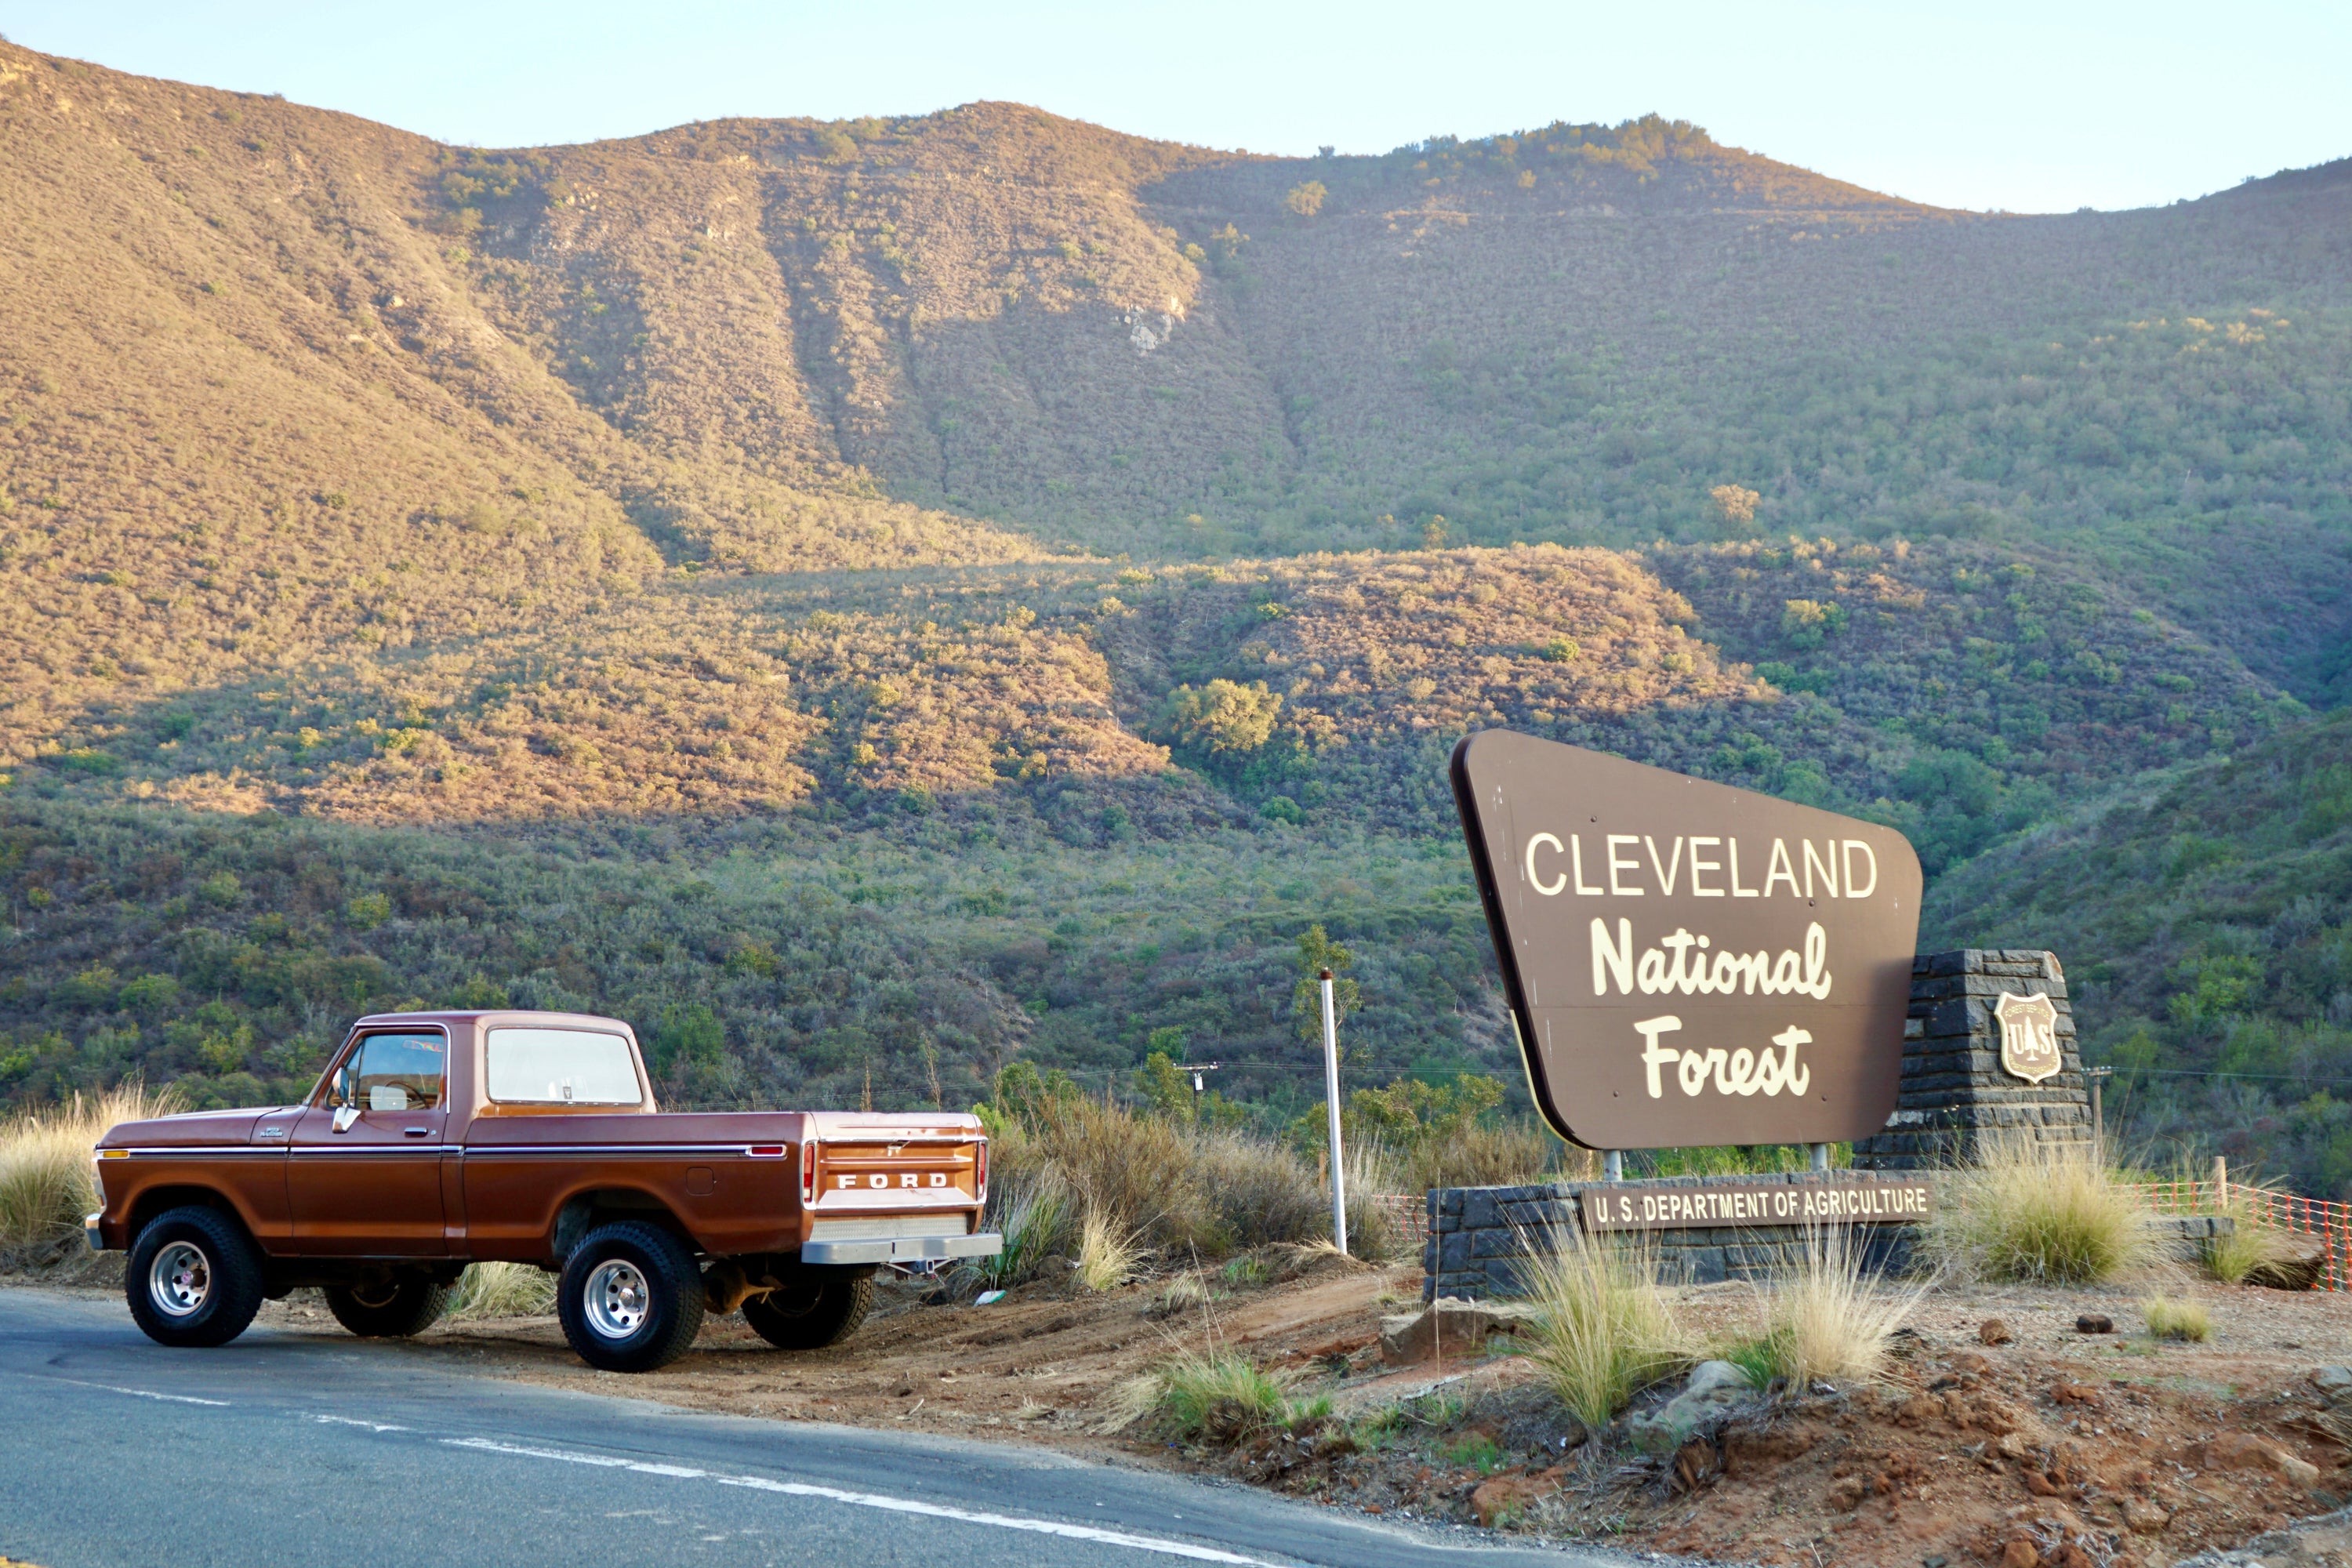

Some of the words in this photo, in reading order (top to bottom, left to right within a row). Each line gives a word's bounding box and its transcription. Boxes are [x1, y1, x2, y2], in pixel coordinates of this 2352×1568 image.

[1525, 833, 1878, 898] CLEVELAND
[1590, 917, 1832, 1000] National
[1633, 1015, 1813, 1099] Forest
[837, 1173, 947, 1189] FORD
[1643, 1192, 1769, 1221] DEPARTMENT
[1774, 1191, 1798, 1217] OF
[1804, 1188, 1928, 1216] AGRICULTURE
